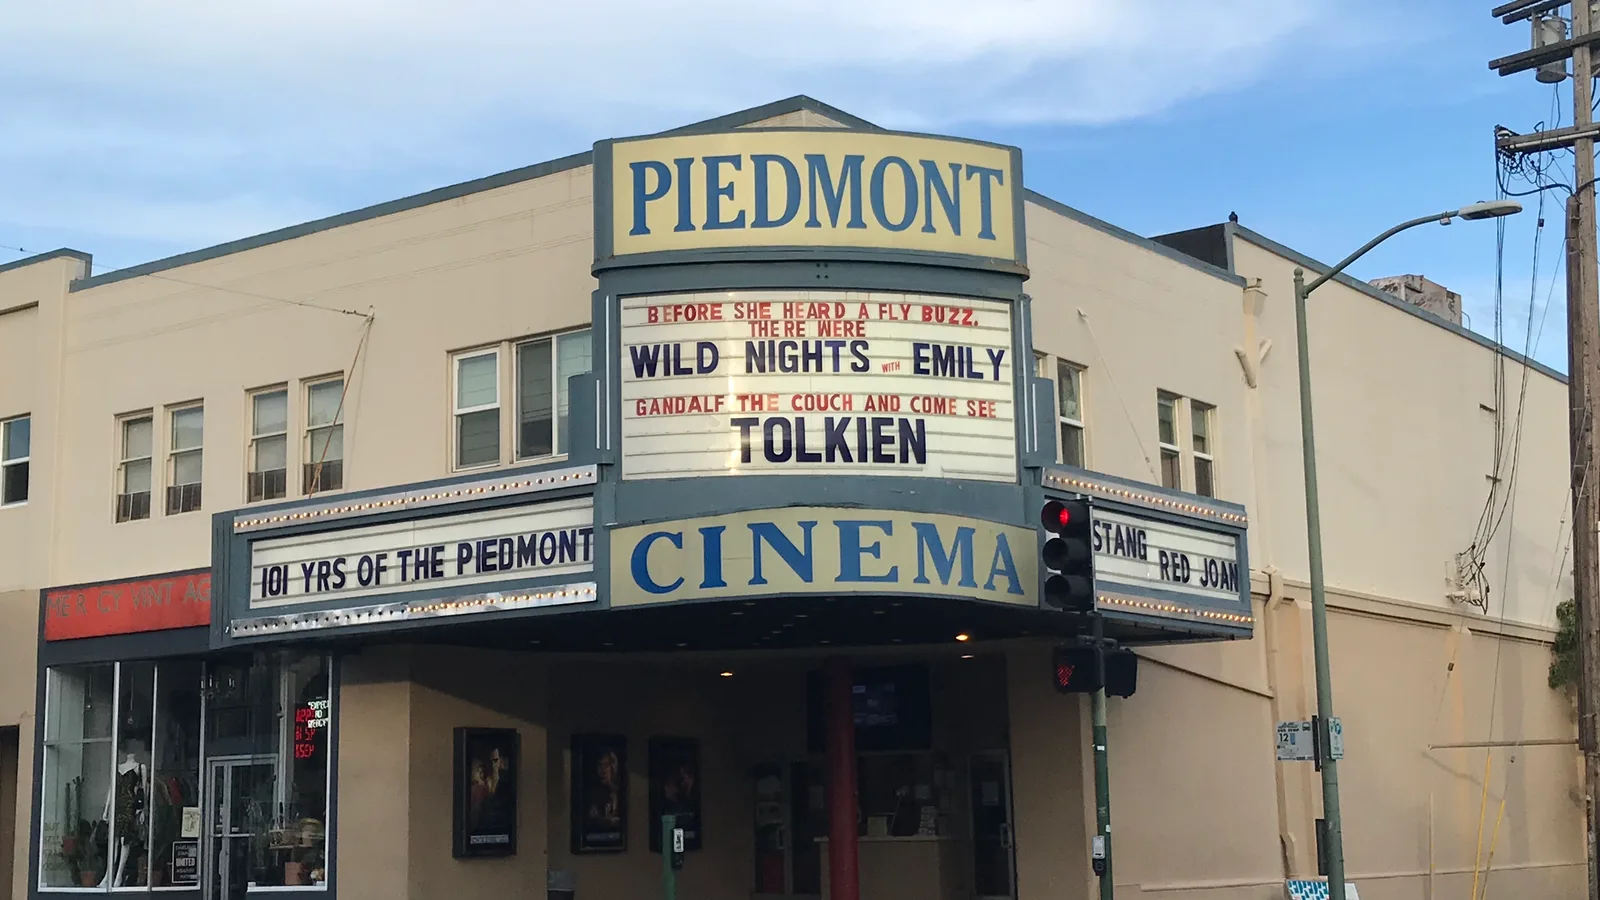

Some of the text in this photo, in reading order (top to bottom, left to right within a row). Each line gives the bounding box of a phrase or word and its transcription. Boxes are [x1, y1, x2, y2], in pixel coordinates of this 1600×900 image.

[629, 153, 1004, 241] PIEDMONT
[647, 304, 723, 324] BEFORE
[734, 301, 771, 320] SHE
[783, 302, 846, 320] HEARD
[858, 303, 870, 320] A
[878, 303, 911, 322] FLY
[748, 320, 866, 338] THERE WERE
[629, 340, 1006, 382] WILD NIGHTS WITH EMILY
[636, 393, 997, 419] GANDALF THE COUCH AND COME SEE
[730, 416, 927, 465] TOLKIEN
[630, 519, 1025, 596] CINEMA
[1093, 520, 1147, 560] STANG
[261, 527, 594, 598] 101 YRS OF THE PIEDMONT
[1158, 549, 1239, 592] RED JOAN
[130, 578, 211, 609] VINTAG
[1279, 733, 1289, 742] 12
